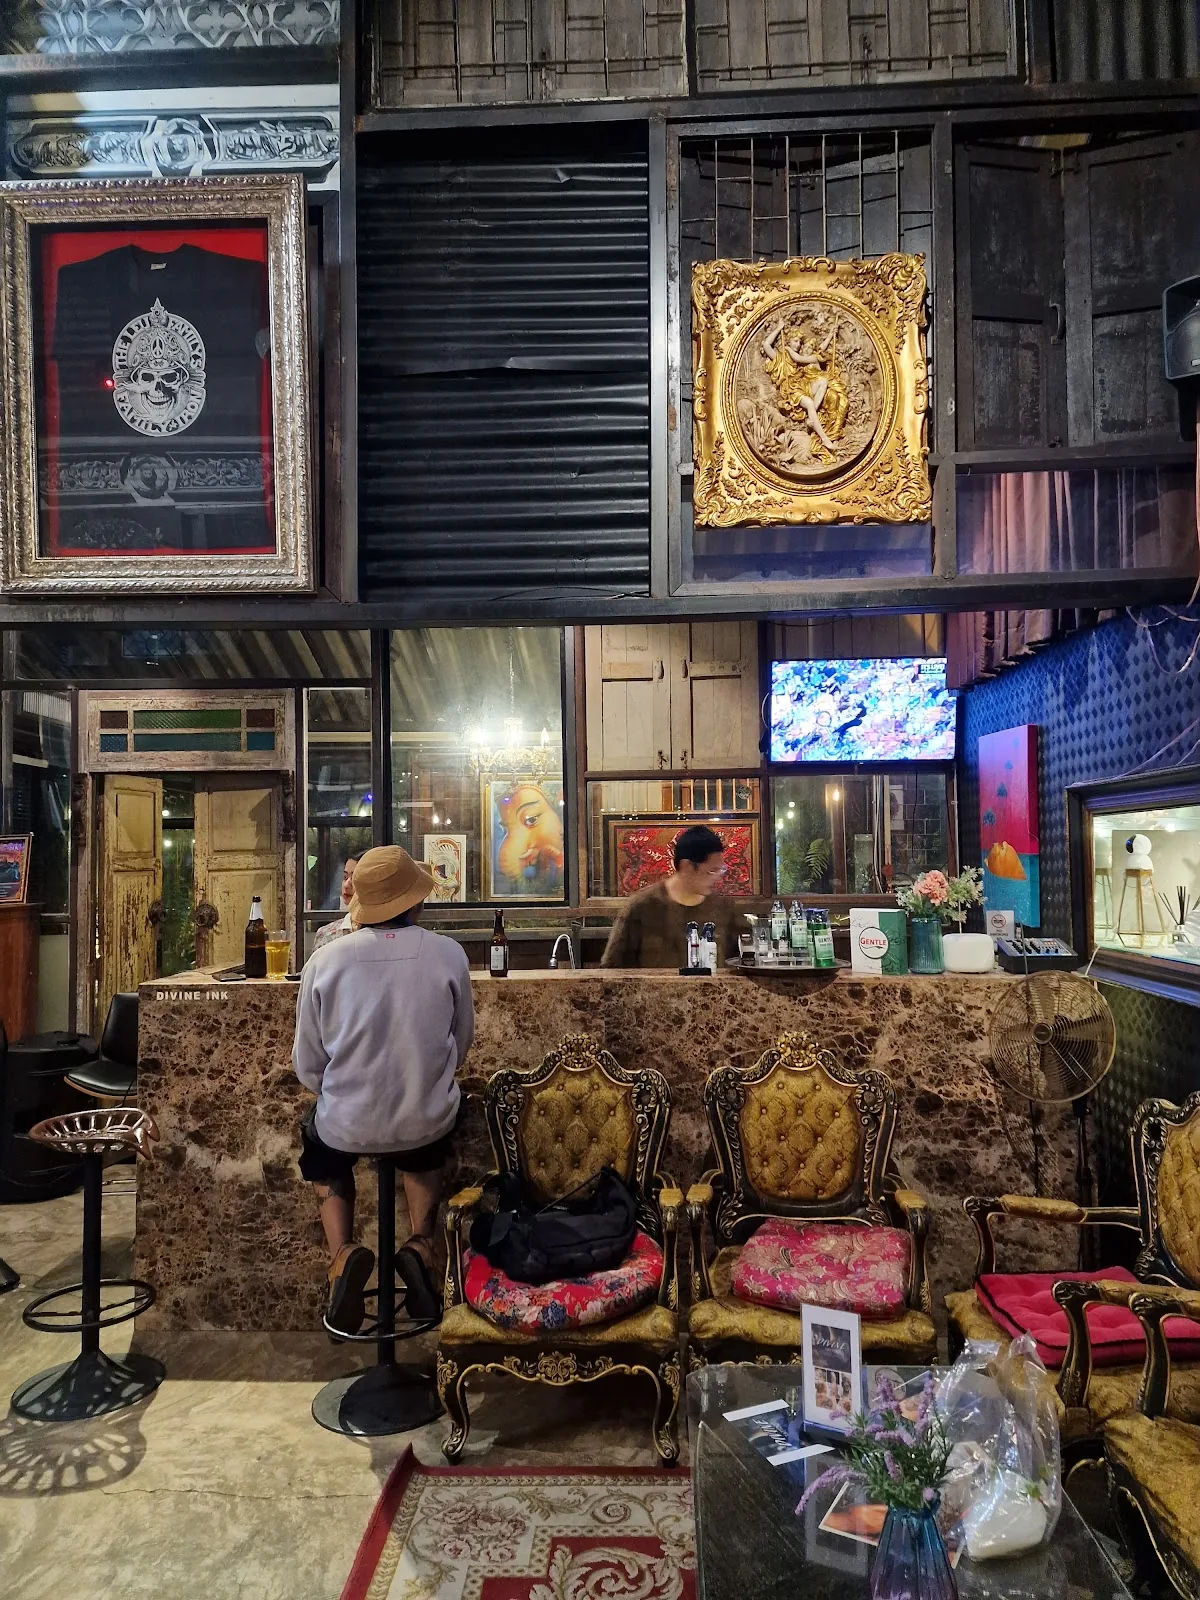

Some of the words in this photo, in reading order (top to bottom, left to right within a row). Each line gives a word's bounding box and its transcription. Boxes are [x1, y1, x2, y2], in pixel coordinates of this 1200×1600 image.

[116, 339, 129, 371] THE
[117, 390, 166, 433] FAMILY
[178, 388, 203, 425] IRON
[860, 937, 887, 946] GENTLE
[156, 991, 201, 1001] DIVINE
[206, 991, 229, 1000] INK
